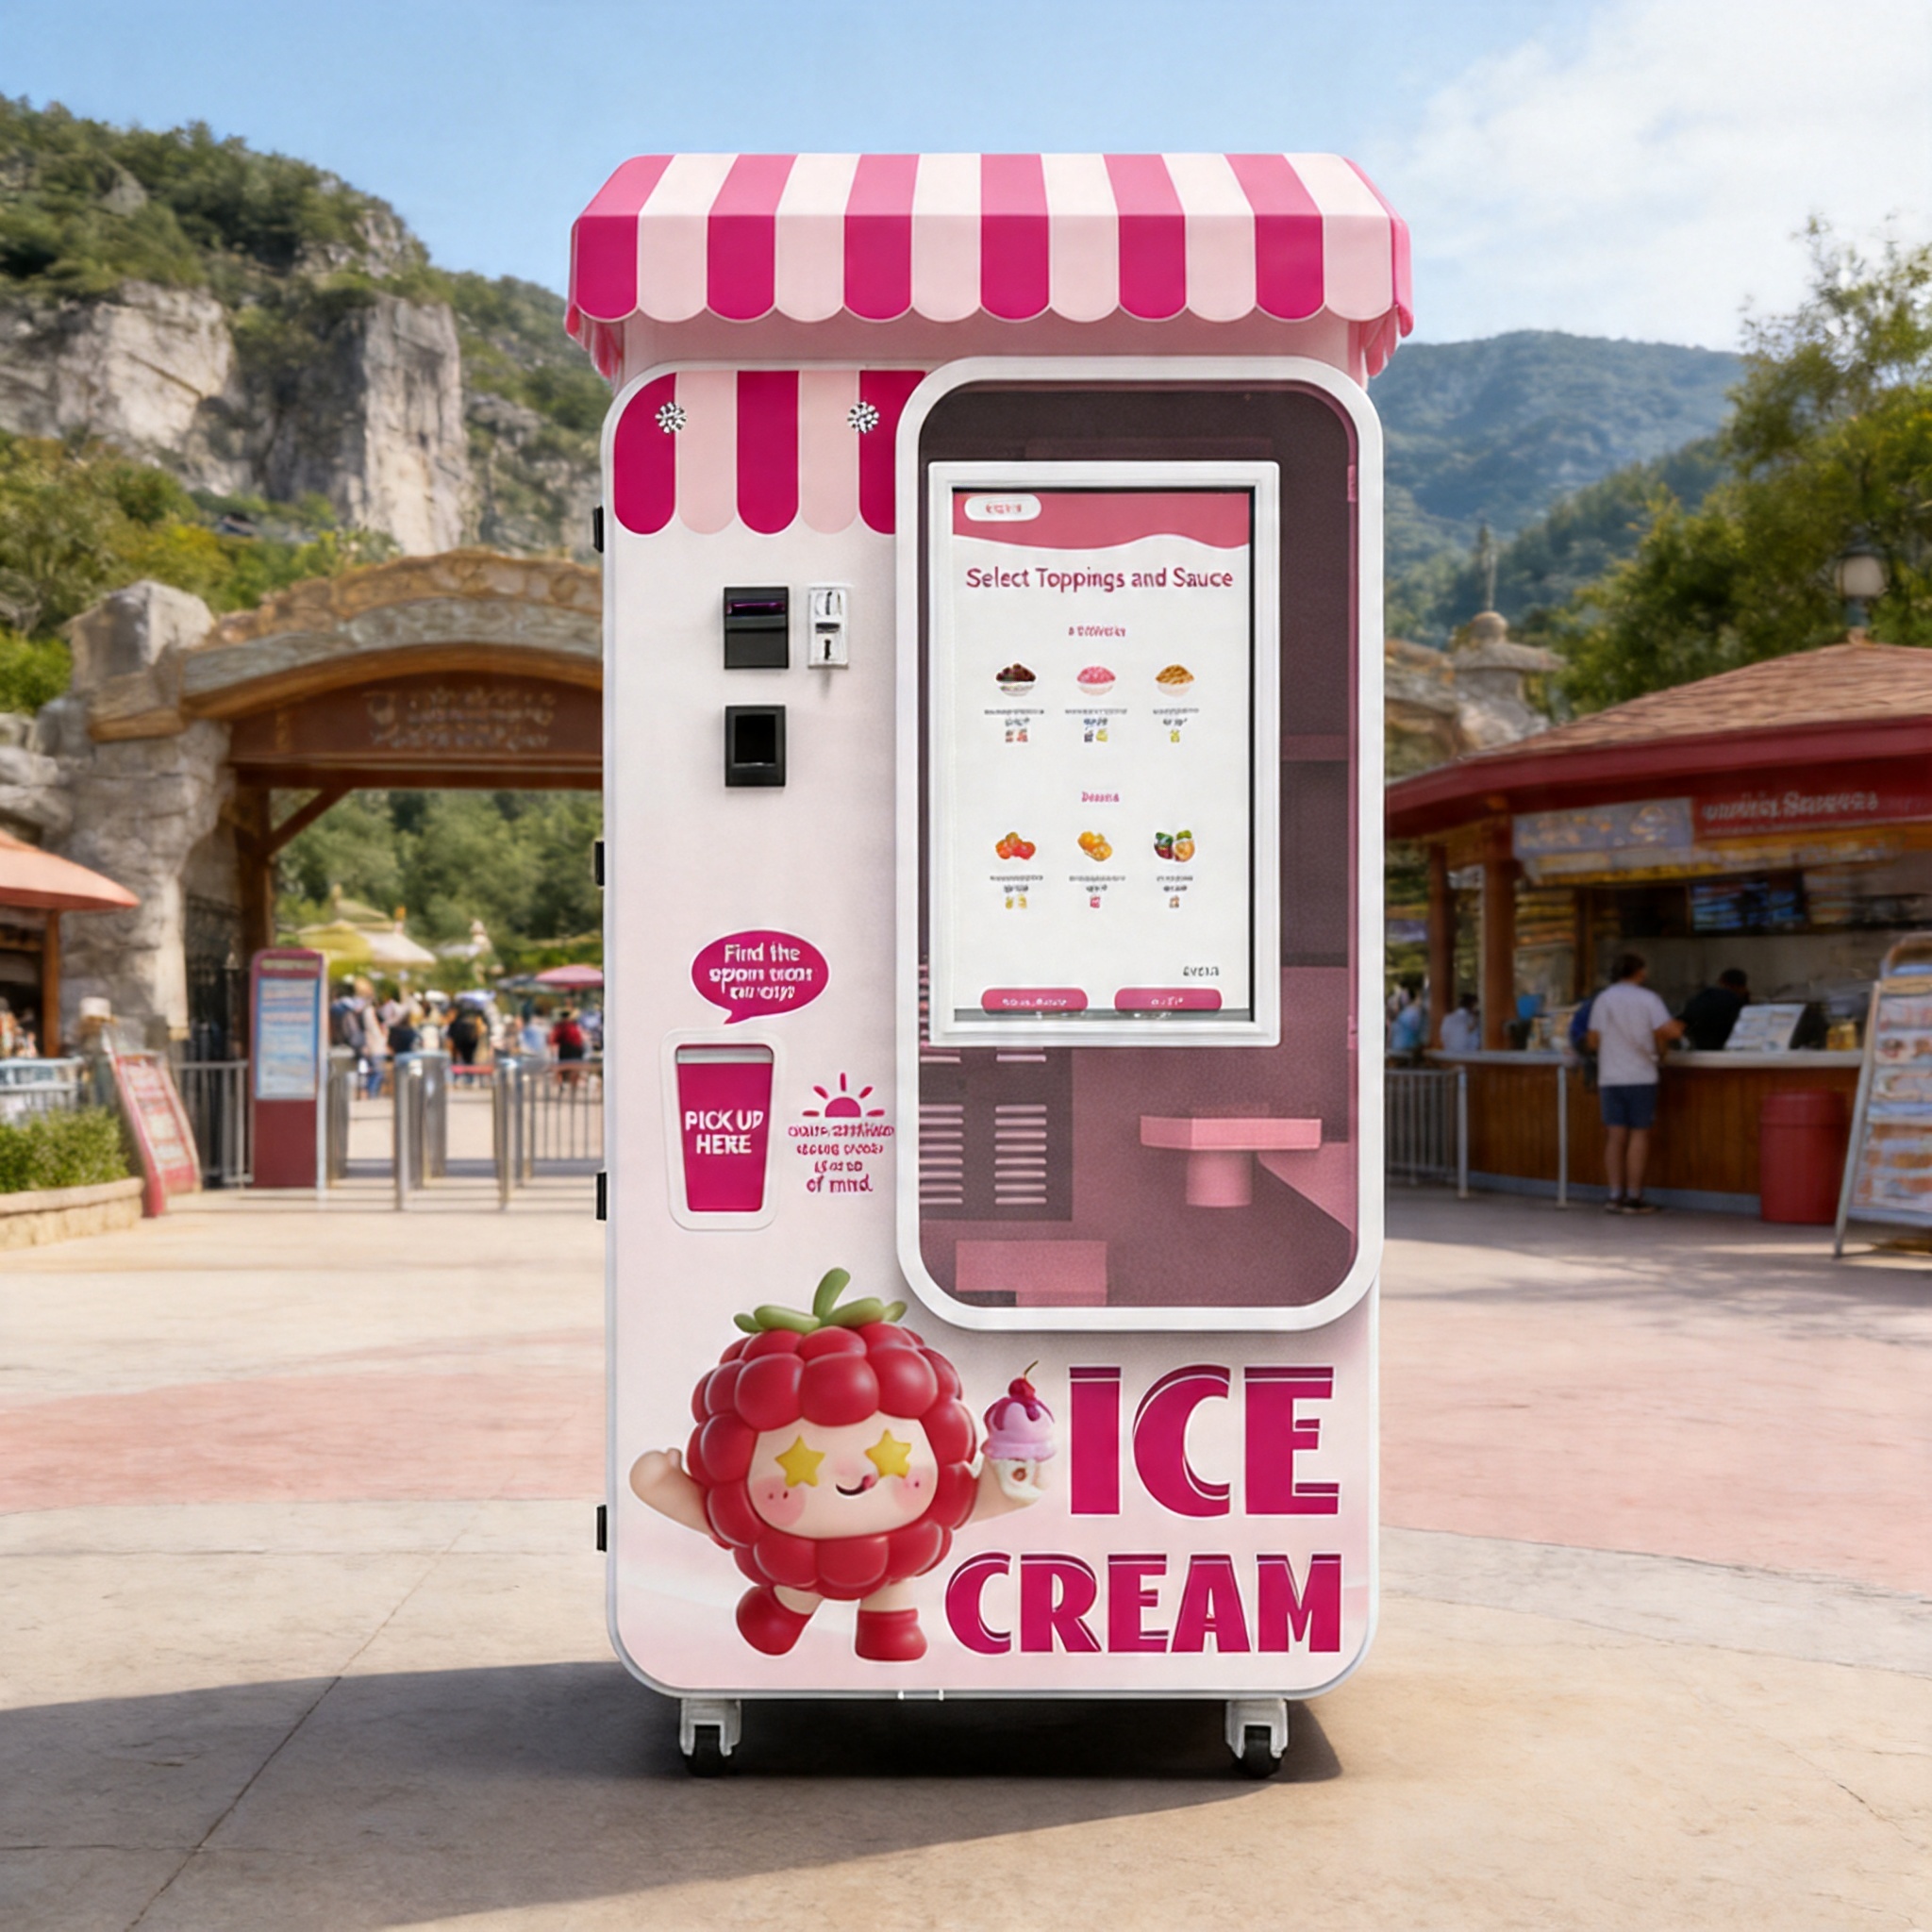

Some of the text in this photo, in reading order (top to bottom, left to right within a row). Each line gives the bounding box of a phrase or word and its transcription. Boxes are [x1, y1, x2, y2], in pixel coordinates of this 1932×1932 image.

[966, 566, 1234, 592] Select Toppings and Sauce
[724, 941, 801, 963] Find the
[685, 1109, 734, 1132] PICK
[736, 1109, 764, 1131] UP
[696, 1134, 752, 1155] HERE
[807, 1174, 824, 1192] of
[1069, 1364, 1340, 1518] ICE
[945, 1552, 1341, 1655] CREAM
